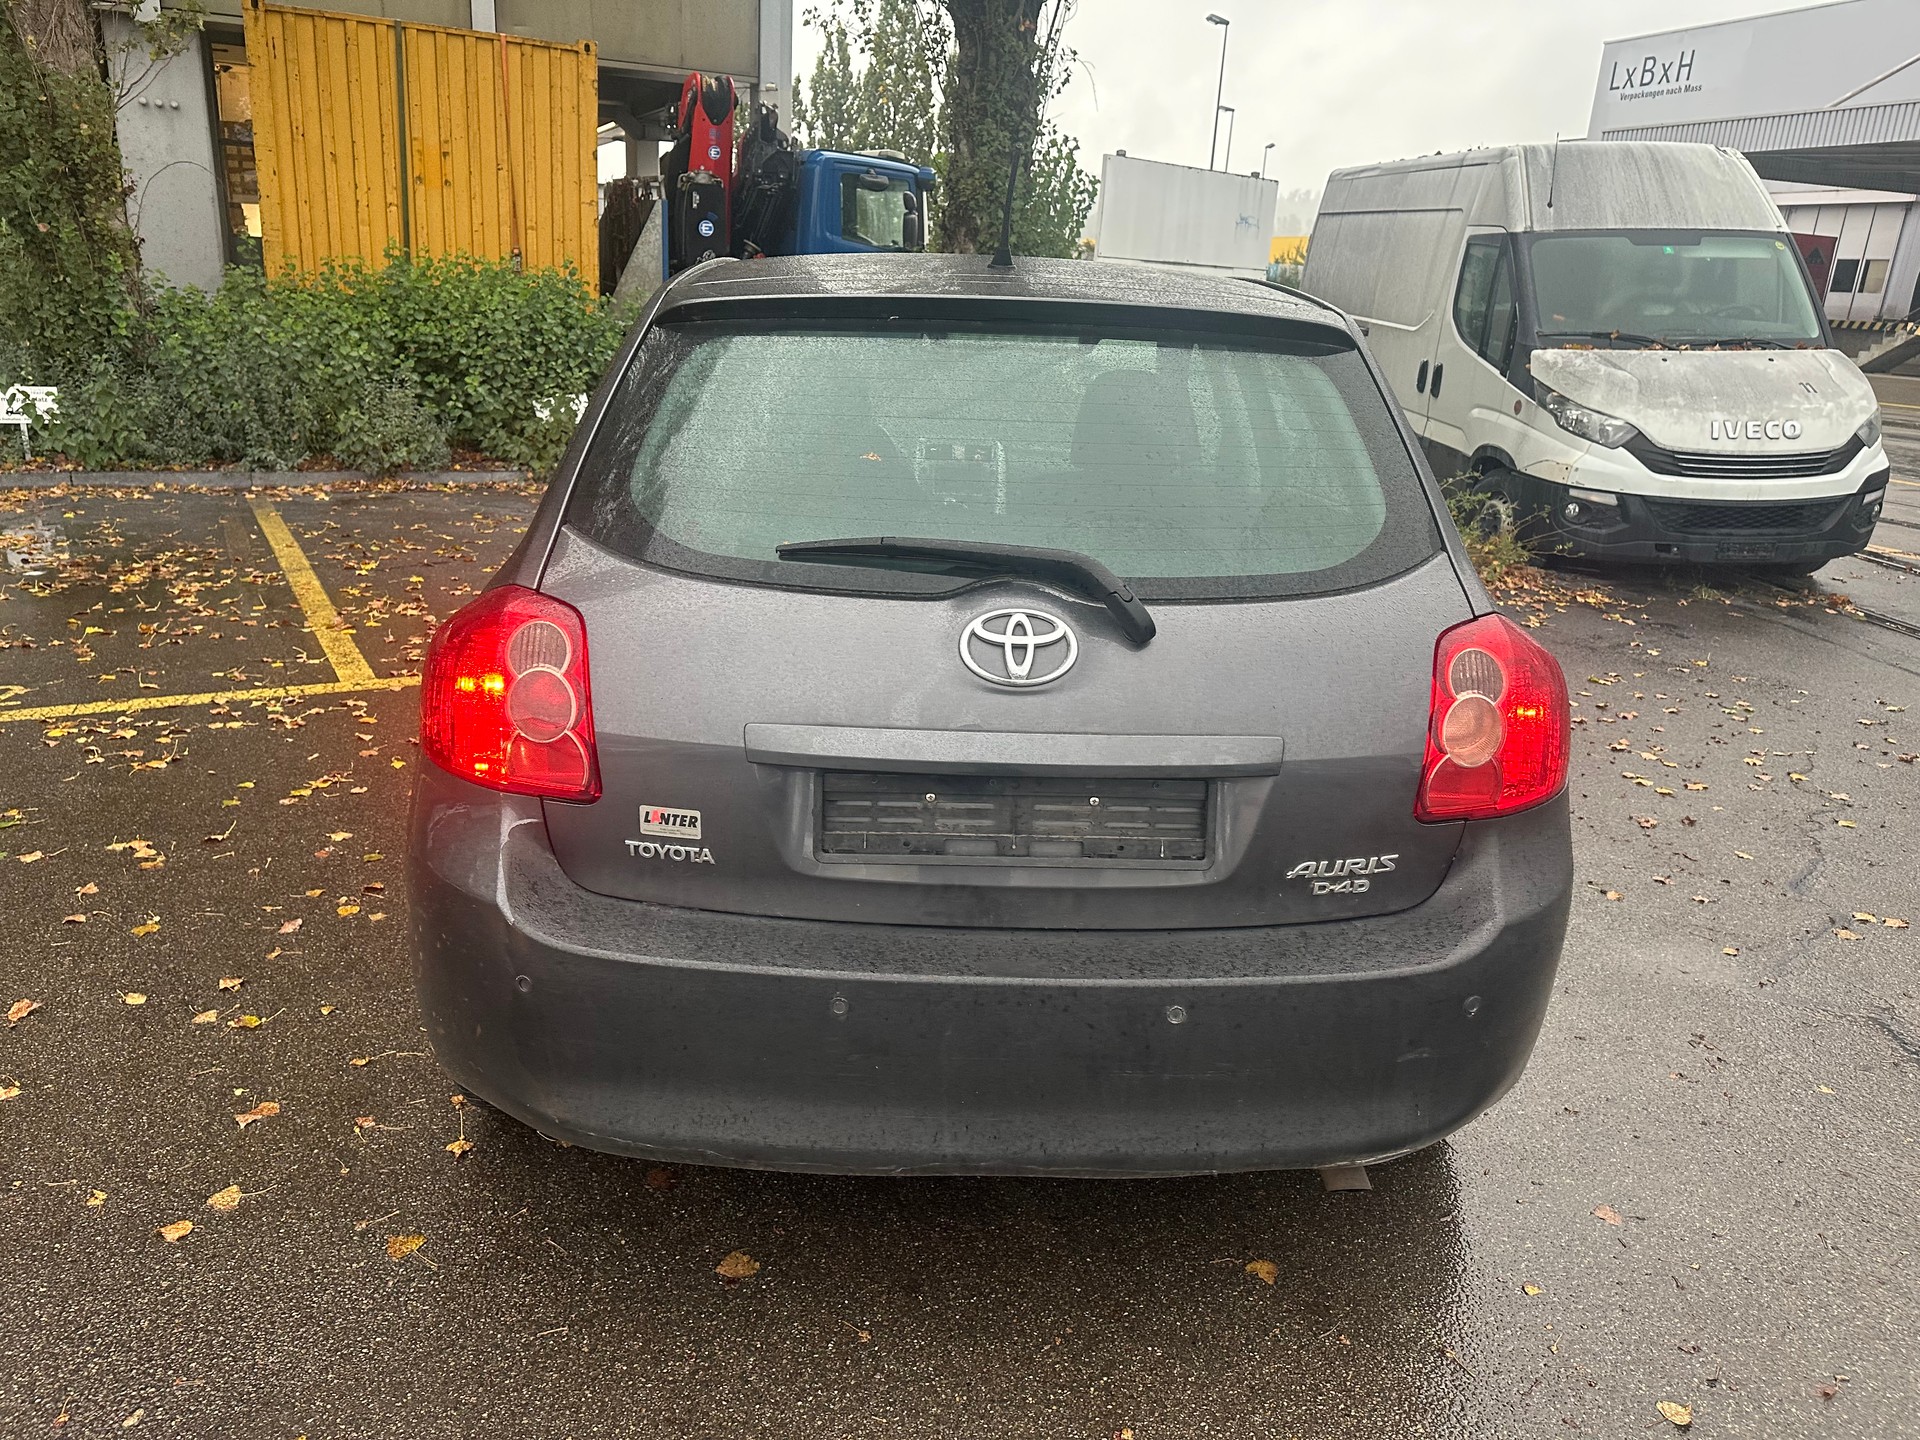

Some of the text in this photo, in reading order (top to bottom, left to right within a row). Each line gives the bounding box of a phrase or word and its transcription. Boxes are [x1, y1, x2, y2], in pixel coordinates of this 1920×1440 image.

[1609, 49, 1696, 91] LxBxH
[1620, 83, 1702, 101] Verpackungen nach Mass
[1711, 420, 1802, 440] IVECO
[625, 840, 716, 865] TOYOTA
[1286, 854, 1399, 879] AURIS
